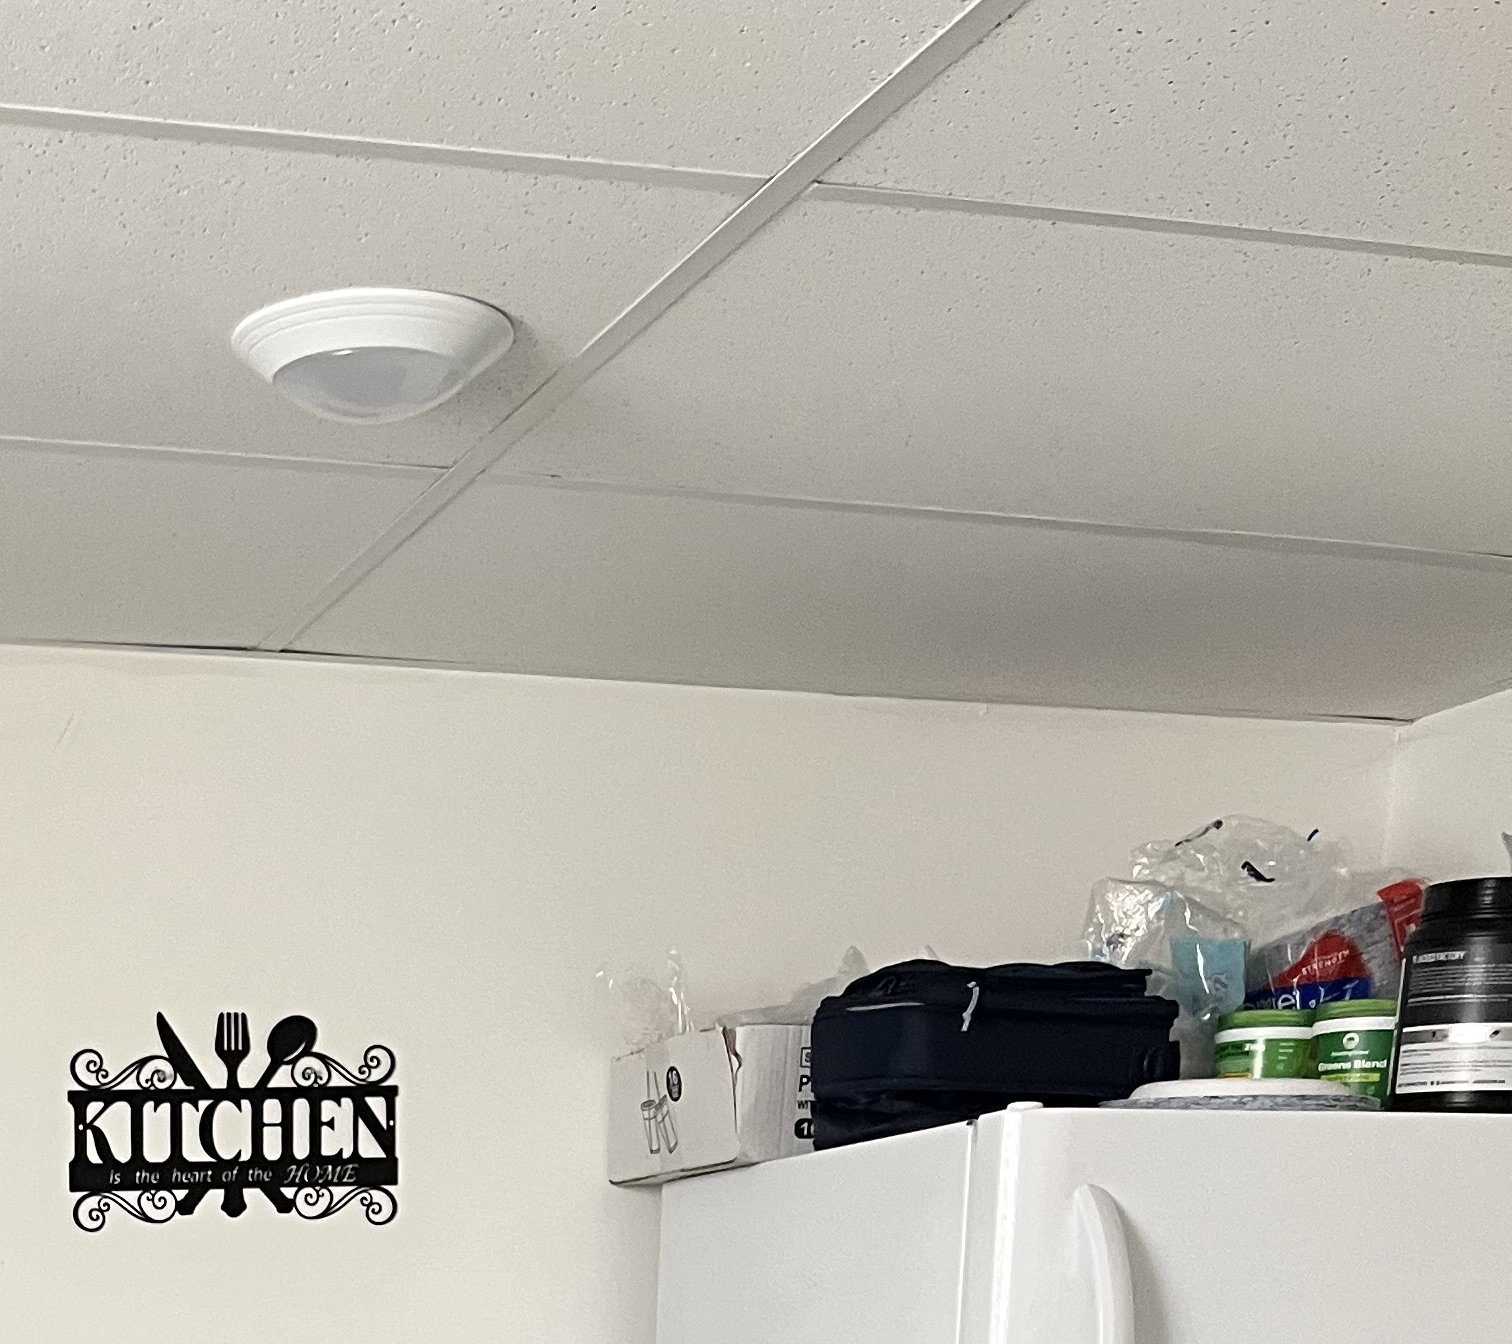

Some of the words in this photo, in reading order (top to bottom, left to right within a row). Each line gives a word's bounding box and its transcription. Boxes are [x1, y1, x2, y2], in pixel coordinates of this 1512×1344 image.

[1301, 950, 1349, 976] STRENGTH
[1318, 1062, 1351, 1072] Greens
[1353, 1059, 1387, 1069] Blend
[68, 1087, 399, 1166] KITCHEN
[135, 1168, 160, 1185] the
[171, 1167, 213, 1184] heart
[221, 1166, 239, 1183] of
[248, 1167, 273, 1183] the
[283, 1163, 358, 1184] HOME
